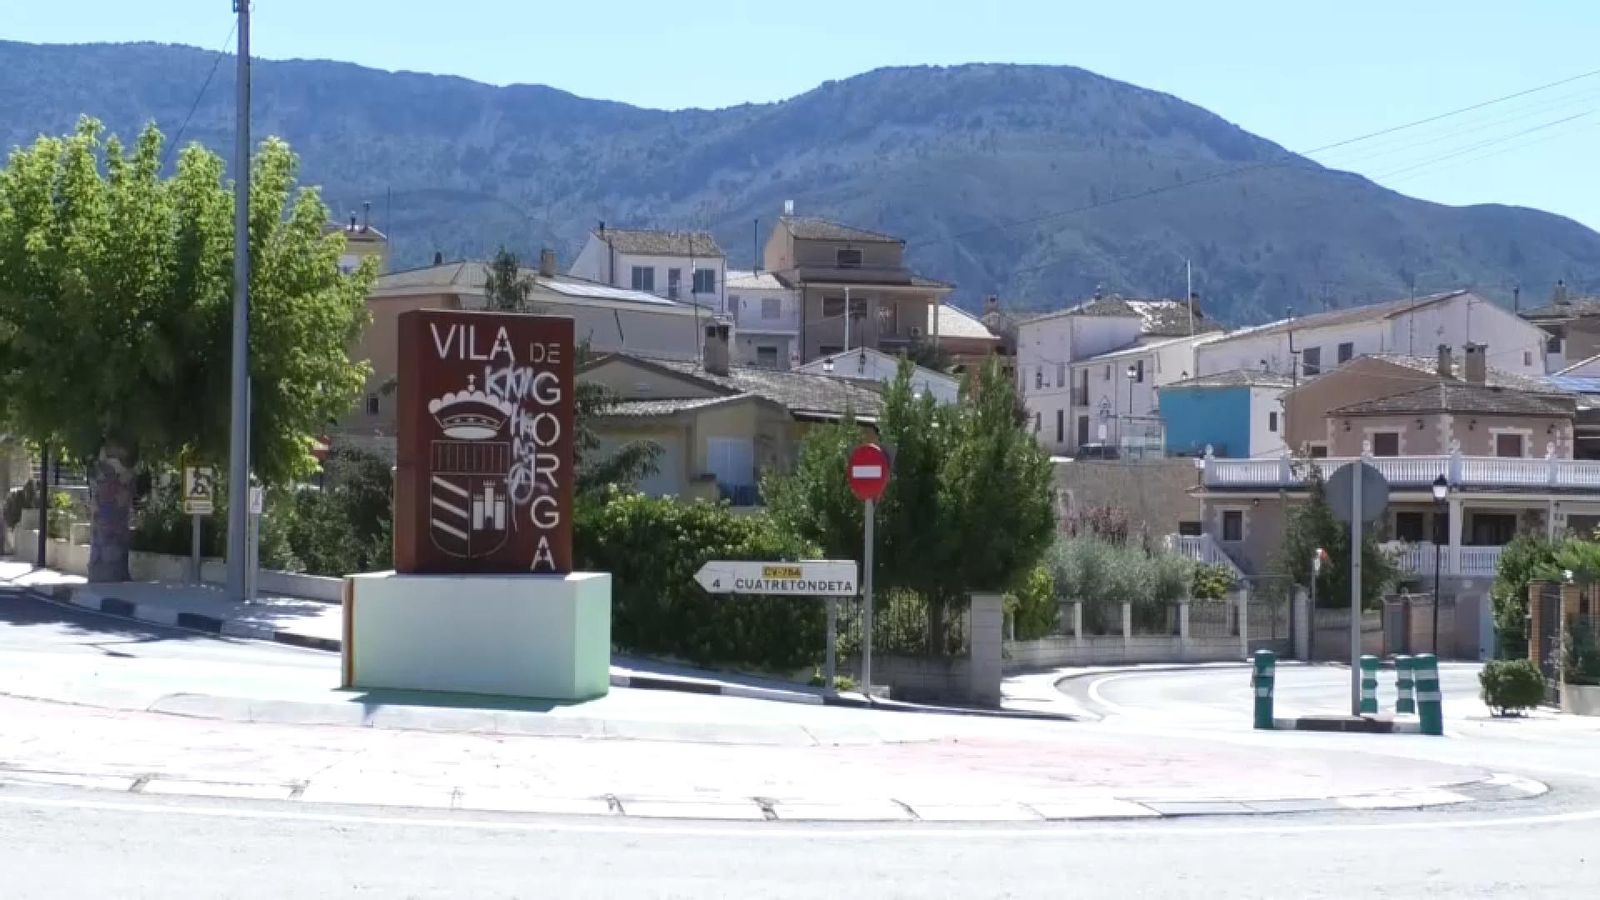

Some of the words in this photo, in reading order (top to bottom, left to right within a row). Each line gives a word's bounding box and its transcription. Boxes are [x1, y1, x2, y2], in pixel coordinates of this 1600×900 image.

[430, 322, 515, 360] VILA
[529, 342, 561, 364] DE
[530, 371, 561, 571] GORGA
[712, 578, 721, 589] 4
[734, 579, 853, 592] CUATRETONDETA
